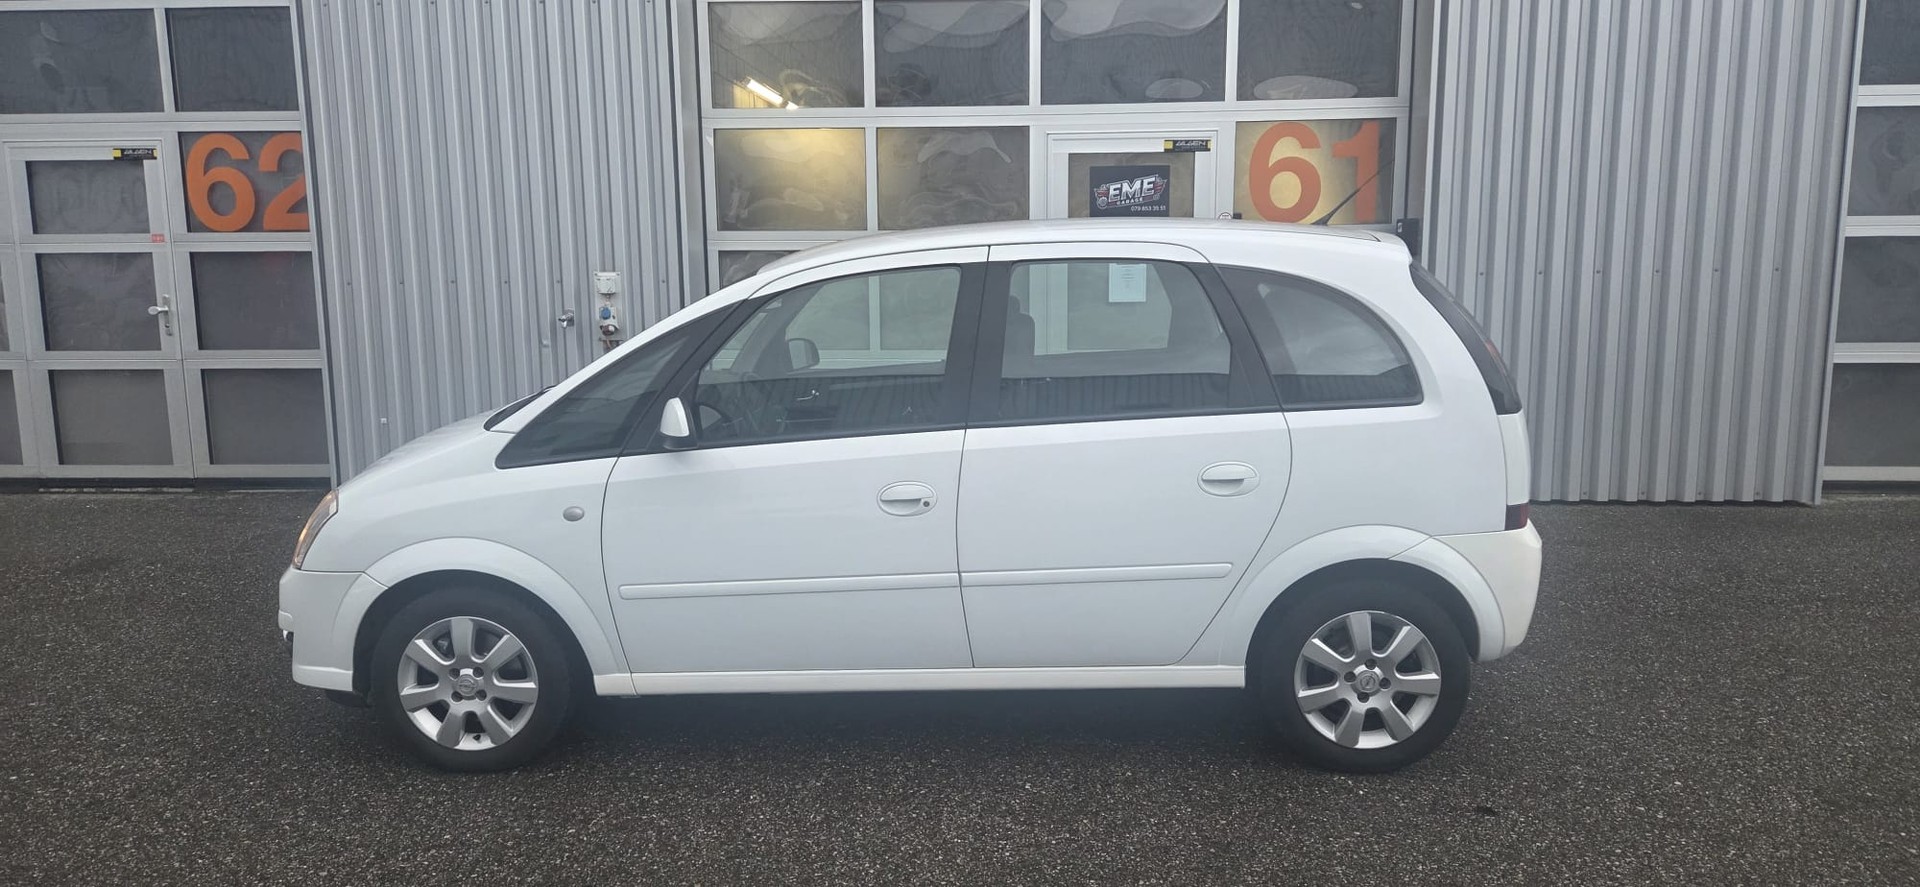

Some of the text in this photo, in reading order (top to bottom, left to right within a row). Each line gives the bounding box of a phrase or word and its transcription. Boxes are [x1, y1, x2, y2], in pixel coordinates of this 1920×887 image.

[186, 133, 310, 232] 62
[1109, 176, 1156, 202] EME
[1116, 197, 1144, 205] GARAGE
[1249, 122, 1380, 224] 61
